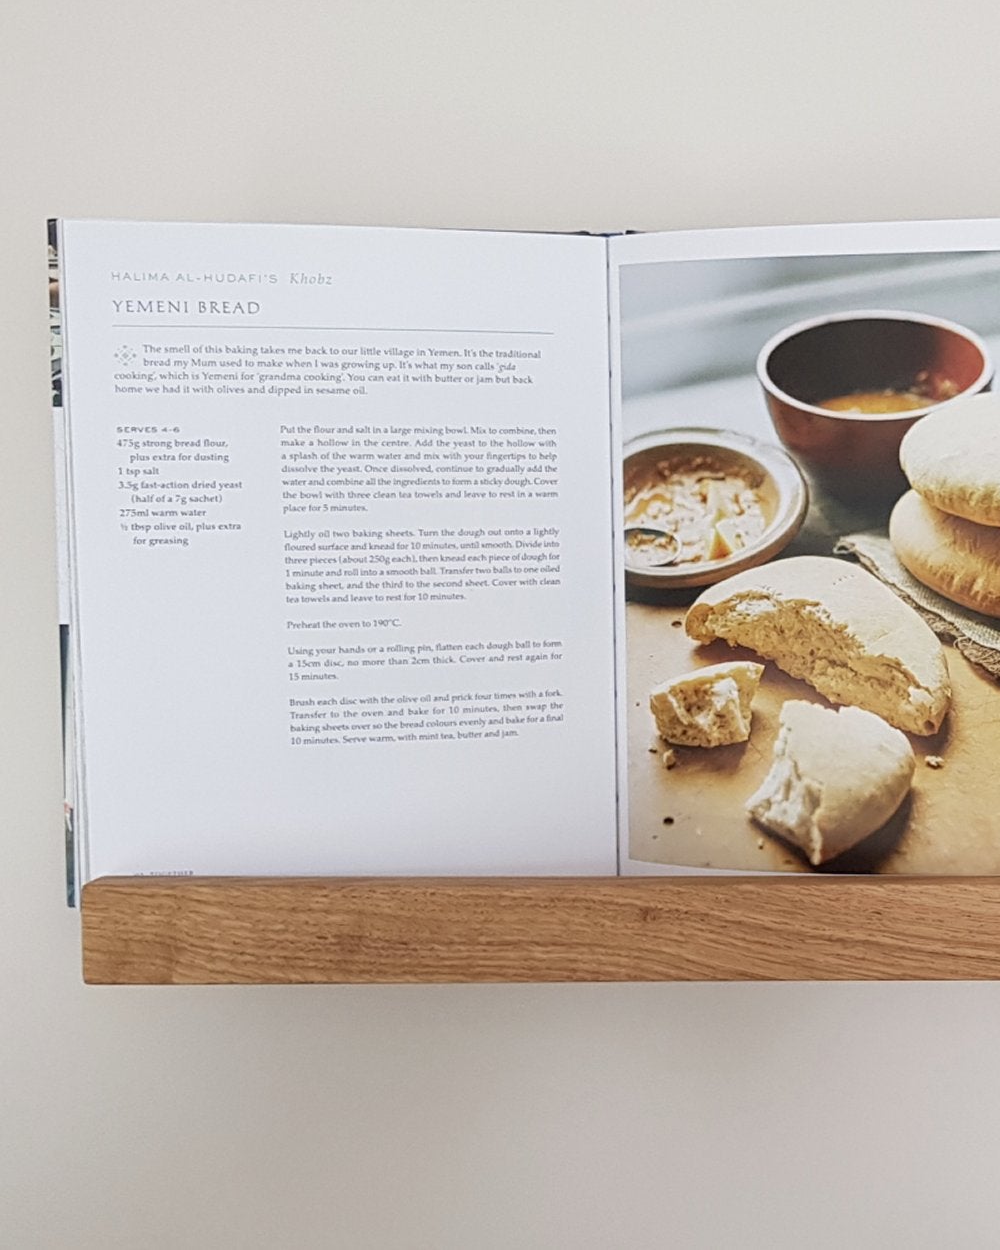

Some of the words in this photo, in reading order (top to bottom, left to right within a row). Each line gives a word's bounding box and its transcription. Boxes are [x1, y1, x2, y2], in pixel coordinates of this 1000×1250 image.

[111, 273, 170, 282] HALIMA
[290, 273, 332, 285] Khobz
[113, 300, 188, 313] YEMENI
[198, 301, 260, 314] BREAD
[143, 345, 162, 354] The
[164, 345, 191, 354] smell
[192, 345, 203, 354] of
[204, 345, 223, 355] this
[225, 346, 259, 357] baking
[260, 346, 286, 355] takes
[305, 347, 328, 356] back
[329, 347, 340, 356] to
[360, 347, 382, 357] little
[383, 348, 415, 359] village
[416, 348, 427, 357] in
[428, 348, 462, 358] Yemen.
[478, 349, 494, 358] the
[495, 349, 542, 359] traditional
[143, 358, 171, 367] bread
[173, 360, 189, 370] my
[191, 358, 217, 368] Mum
[219, 359, 243, 368] used
[244, 359, 255, 368] to
[257, 359, 283, 368] make
[285, 359, 313, 369] when
[314, 360, 318, 369] I
[341, 360, 381, 372] growing
[382, 363, 397, 372] up.
[414, 361, 438, 370] what
[440, 363, 455, 372] my
[474, 361, 495, 370] calls
[159, 372, 189, 381] which
[191, 372, 200, 381] is
[202, 372, 239, 381] Yemeni
[240, 372, 255, 381] for
[347, 373, 366, 382] You
[386, 374, 401, 383] eat
[403, 374, 410, 383] it
[411, 374, 433, 383] with
[434, 374, 462, 383] butter
[476, 374, 494, 386] jam
[495, 374, 511, 384] but
[512, 374, 533, 384] back
[114, 384, 143, 393] home
[162, 384, 181, 393] had
[183, 384, 190, 393] it
[192, 384, 214, 394] with
[216, 384, 245, 394] olives
[247, 385, 266, 394] and
[268, 385, 302, 396] dipped
[303, 385, 314, 394] in
[352, 386, 369, 395] oil.
[280, 425, 296, 434] Put
[297, 425, 312, 434] the
[313, 425, 335, 434] flour
[336, 425, 354, 434] and
[355, 425, 371, 434] salt
[372, 426, 382, 434] in
[390, 426, 412, 437] large
[413, 426, 444, 437] mixing
[470, 426, 487, 435] Mix
[488, 426, 498, 435] to
[498, 426, 537, 436] combine,
[538, 426, 557, 435] then
[117, 438, 140, 450] 475g
[142, 438, 173, 450] strong
[174, 438, 201, 447] bread
[203, 438, 228, 448] flour,
[280, 438, 306, 447] make
[317, 438, 349, 447] hollow
[351, 438, 361, 447] in
[363, 438, 379, 447] the
[381, 438, 412, 447] centre.
[415, 438, 433, 447] Add
[436, 438, 450, 447] the
[453, 438, 476, 449] yeast
[478, 438, 488, 447] to
[490, 438, 504, 447] the
[506, 438, 536, 447] hollow
[538, 438, 557, 447] with
[130, 452, 150, 464] plus
[152, 452, 176, 461] extra
[178, 452, 192, 461] for
[193, 452, 230, 464] dusting
[118, 466, 123, 475] 1
[126, 466, 141, 477] tsp
[143, 466, 160, 475] salt
[191, 480, 217, 489] dried
[218, 480, 243, 491] yeast
[131, 494, 154, 505] (half
[155, 494, 166, 503] of
[175, 494, 187, 505] 7g
[189, 494, 223, 504] sachet)
[180, 508, 206, 517] water
[283, 503, 307, 514] place
[308, 503, 321, 512] for
[323, 503, 329, 512] 5
[330, 503, 369, 512] minutes.
[131, 522, 152, 533] tbsp
[153, 522, 177, 531] olive
[179, 522, 194, 532] oil,
[196, 522, 216, 533] plus
[218, 522, 242, 531] extra
[133, 536, 146, 544] for
[149, 536, 189, 547] greasing
[286, 620, 321, 629] Preheat
[322, 619, 337, 628] the
[362, 619, 372, 628] to
[287, 646, 314, 657] Using
[315, 647, 336, 656] your
[338, 644, 366, 654] hands
[386, 643, 416, 654] rolling
[417, 642, 434, 654] pin,
[435, 642, 463, 651] flatten
[465, 641, 485, 650] each
[486, 640, 514, 652] dough
[515, 640, 531, 649] ball
[532, 639, 541, 648] to
[542, 639, 562, 648] form
